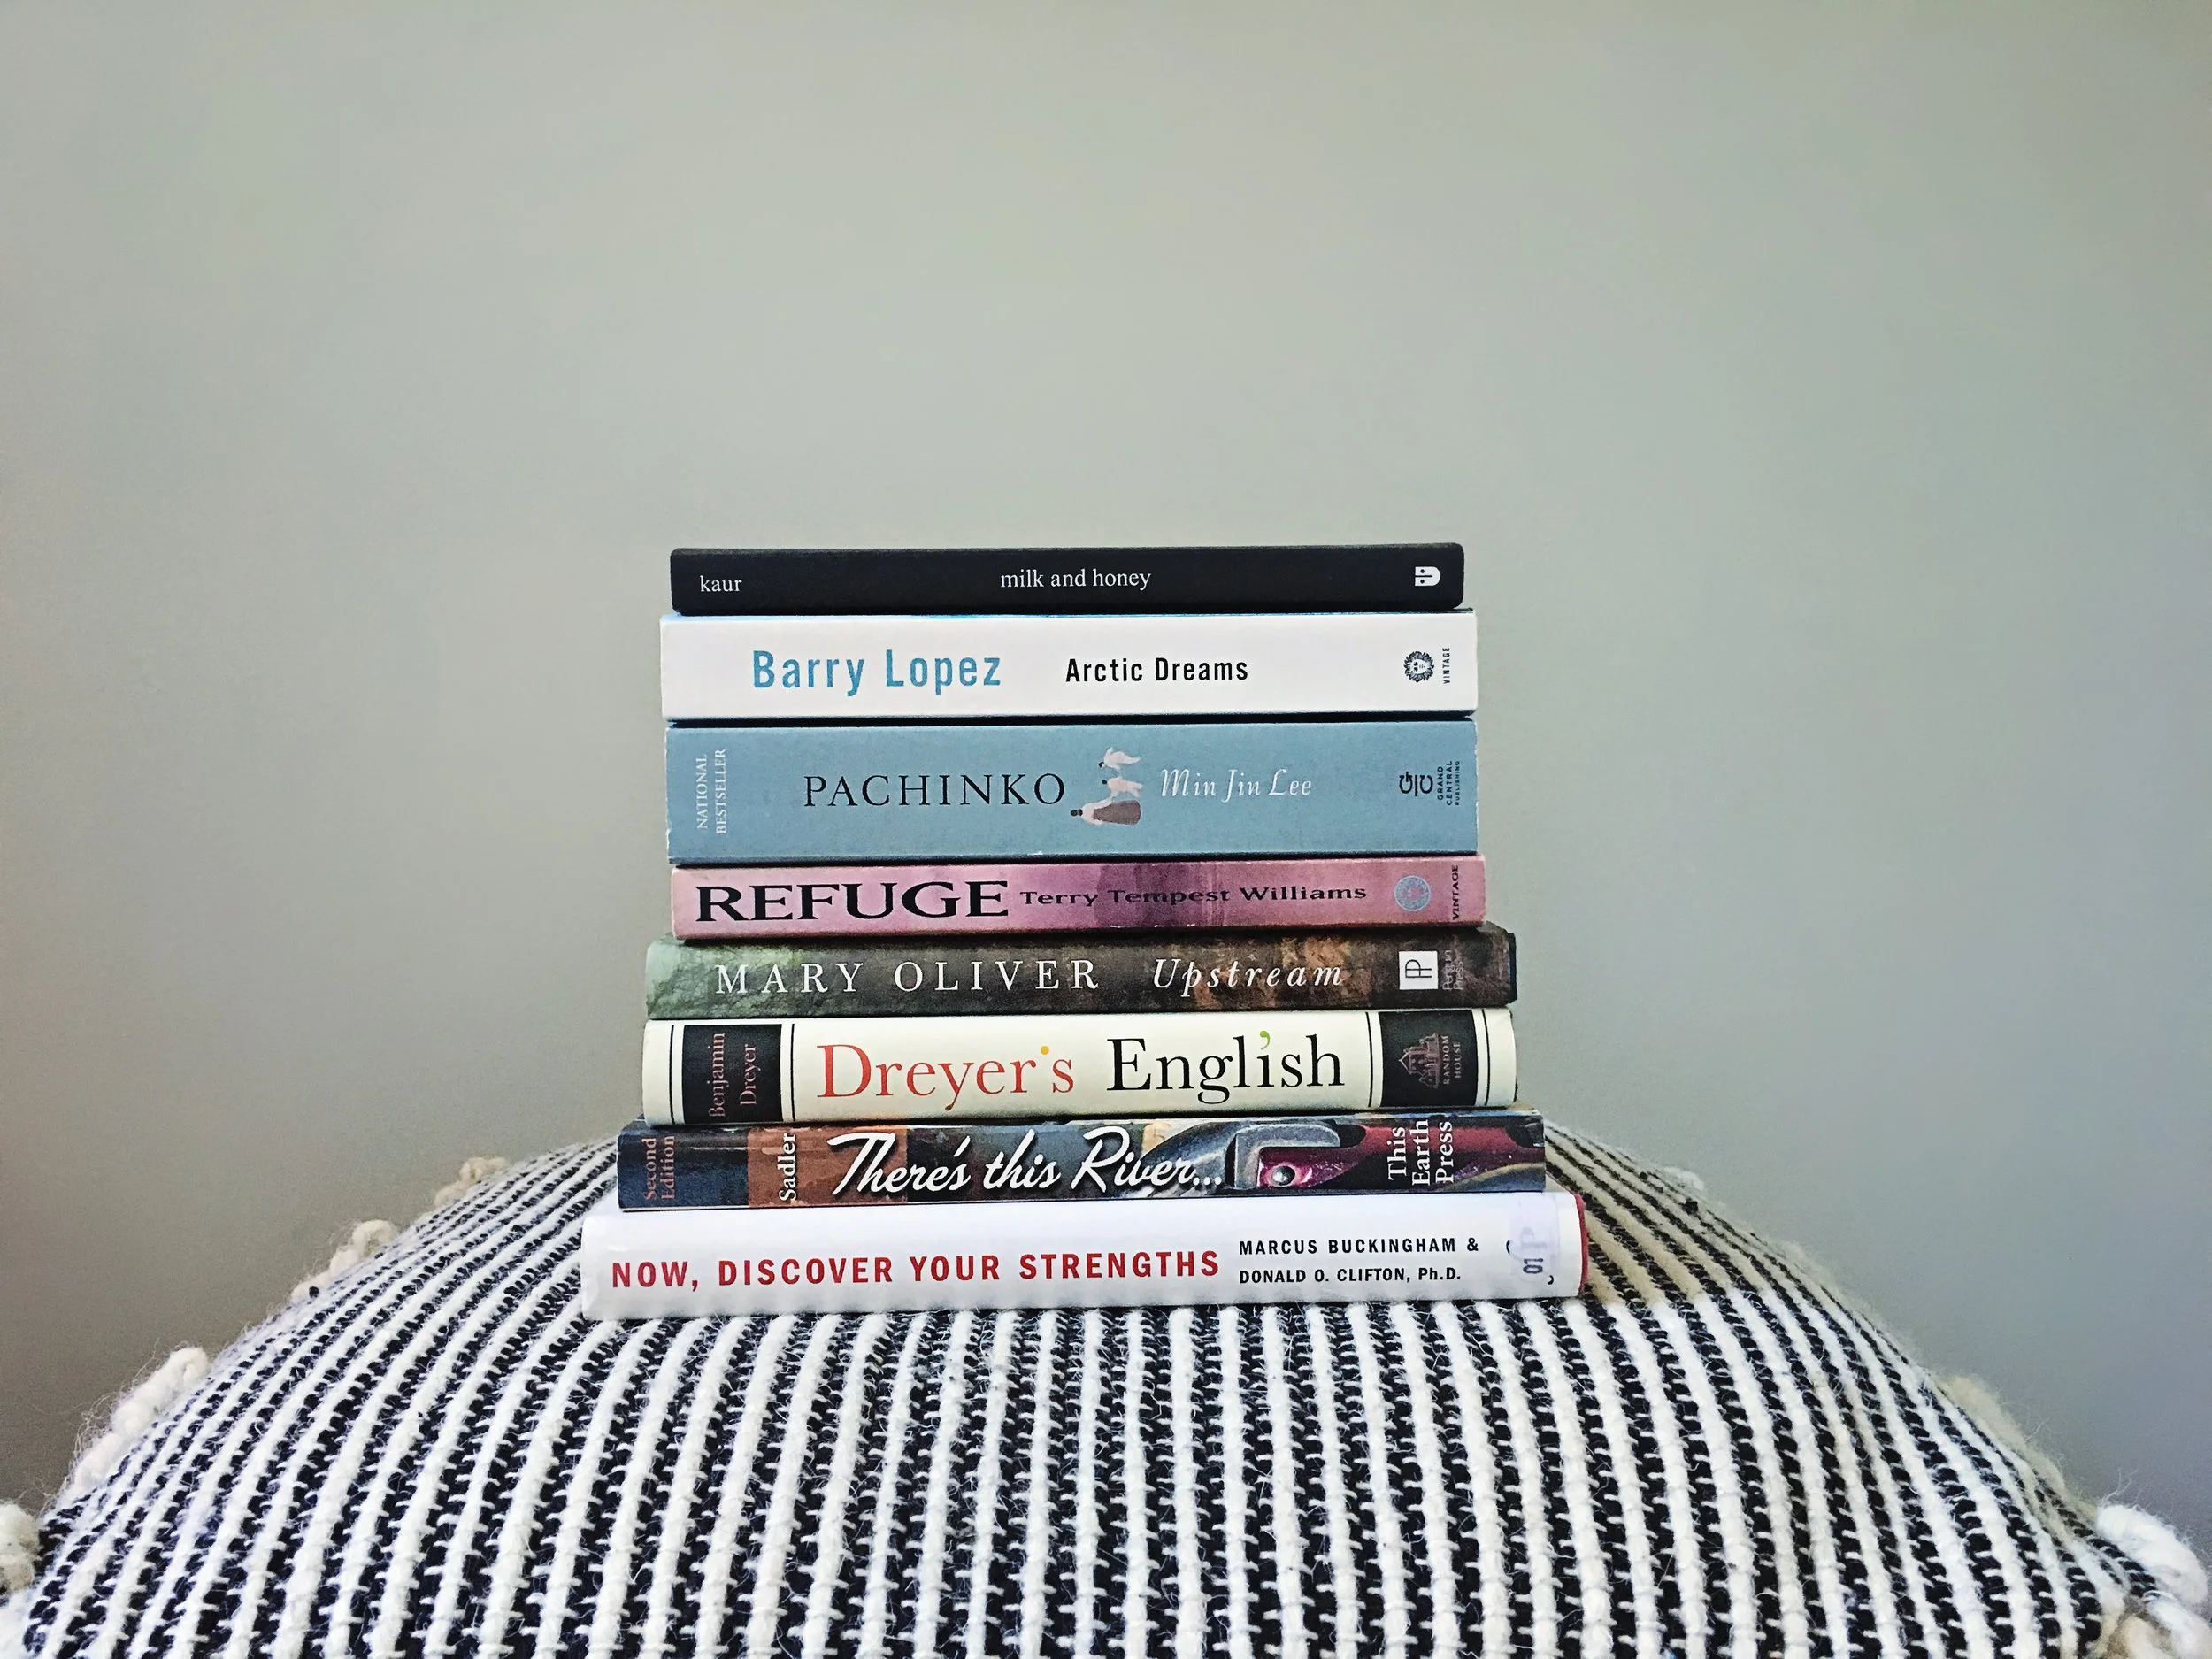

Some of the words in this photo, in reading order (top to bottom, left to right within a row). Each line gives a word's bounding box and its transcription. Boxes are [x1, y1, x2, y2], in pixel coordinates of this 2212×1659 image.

[700, 576, 742, 593] kaur
[1000, 569, 1045, 588] milk
[1051, 569, 1086, 588] and
[1093, 569, 1152, 590] honey
[753, 650, 865, 697] Barry
[886, 649, 1001, 695] Lopez
[1065, 658, 1143, 683] Arctic
[1155, 657, 1249, 681] Dreams
[1442, 647, 1451, 685] VINTAGE
[696, 754, 708, 830] NATIONAL
[715, 749, 727, 835] BESTSELLER
[803, 773, 1065, 807] PACHINKO
[1160, 769, 1217, 797] Min
[1221, 769, 1261, 802] Jin
[1267, 768, 1313, 797] Lee
[695, 880, 1009, 922] REFUGE
[1019, 890, 1098, 906] Terry
[1112, 887, 1230, 905] Tempest
[1240, 885, 1368, 901] Williams
[716, 963, 864, 994] MARY
[894, 959, 1099, 992] OLIVER
[1152, 958, 1343, 997] Upstream
[1454, 960, 1465, 991] Press
[707, 1033, 729, 1118] Benjamin
[740, 1044, 761, 1106] Dreyer
[818, 1044, 1074, 1111] Dreyer's
[1106, 1030, 1345, 1105] English
[641, 1138, 657, 1201] Second
[660, 1135, 675, 1199] Edition
[777, 1133, 796, 1202] Sadler
[827, 1131, 971, 1196] There's
[983, 1128, 1062, 1190] this
[1386, 1126, 1407, 1181] This
[1409, 1119, 1431, 1186] Earth
[1435, 1121, 1454, 1183] Press
[1240, 1239, 1317, 1255] MARCUS
[1328, 1237, 1455, 1254] BUCKINGHAM
[1466, 1237, 1479, 1252] &
[612, 1260, 699, 1292] NOW,
[718, 1256, 893, 1286] DISCOVER
[909, 1255, 1000, 1282] YOUR
[1019, 1249, 1219, 1280] STRENGTHS
[1240, 1268, 1307, 1283] DONALD
[1314, 1269, 1330, 1282] O.
[1337, 1268, 1411, 1283] CLIFTON,
[1418, 1267, 1462, 1281] Ph.D.
